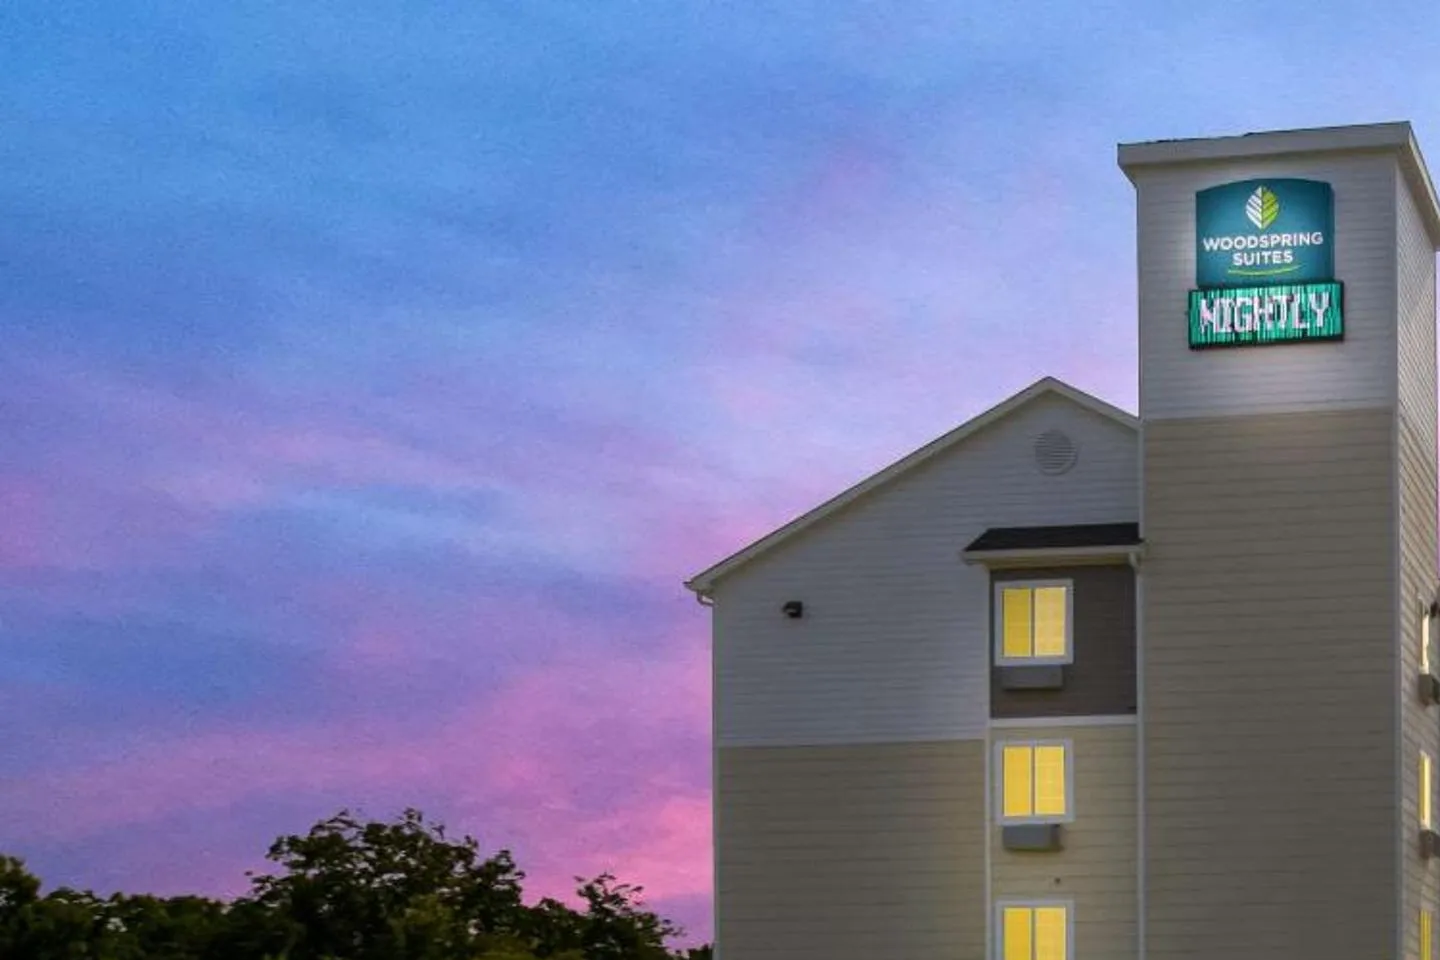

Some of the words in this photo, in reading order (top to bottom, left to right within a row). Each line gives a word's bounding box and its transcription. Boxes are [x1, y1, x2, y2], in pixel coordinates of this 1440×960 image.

[1203, 231, 1323, 251] WOODSPRING
[1232, 250, 1294, 266] SUITES
[1200, 291, 1330, 333] NIGHTLY
